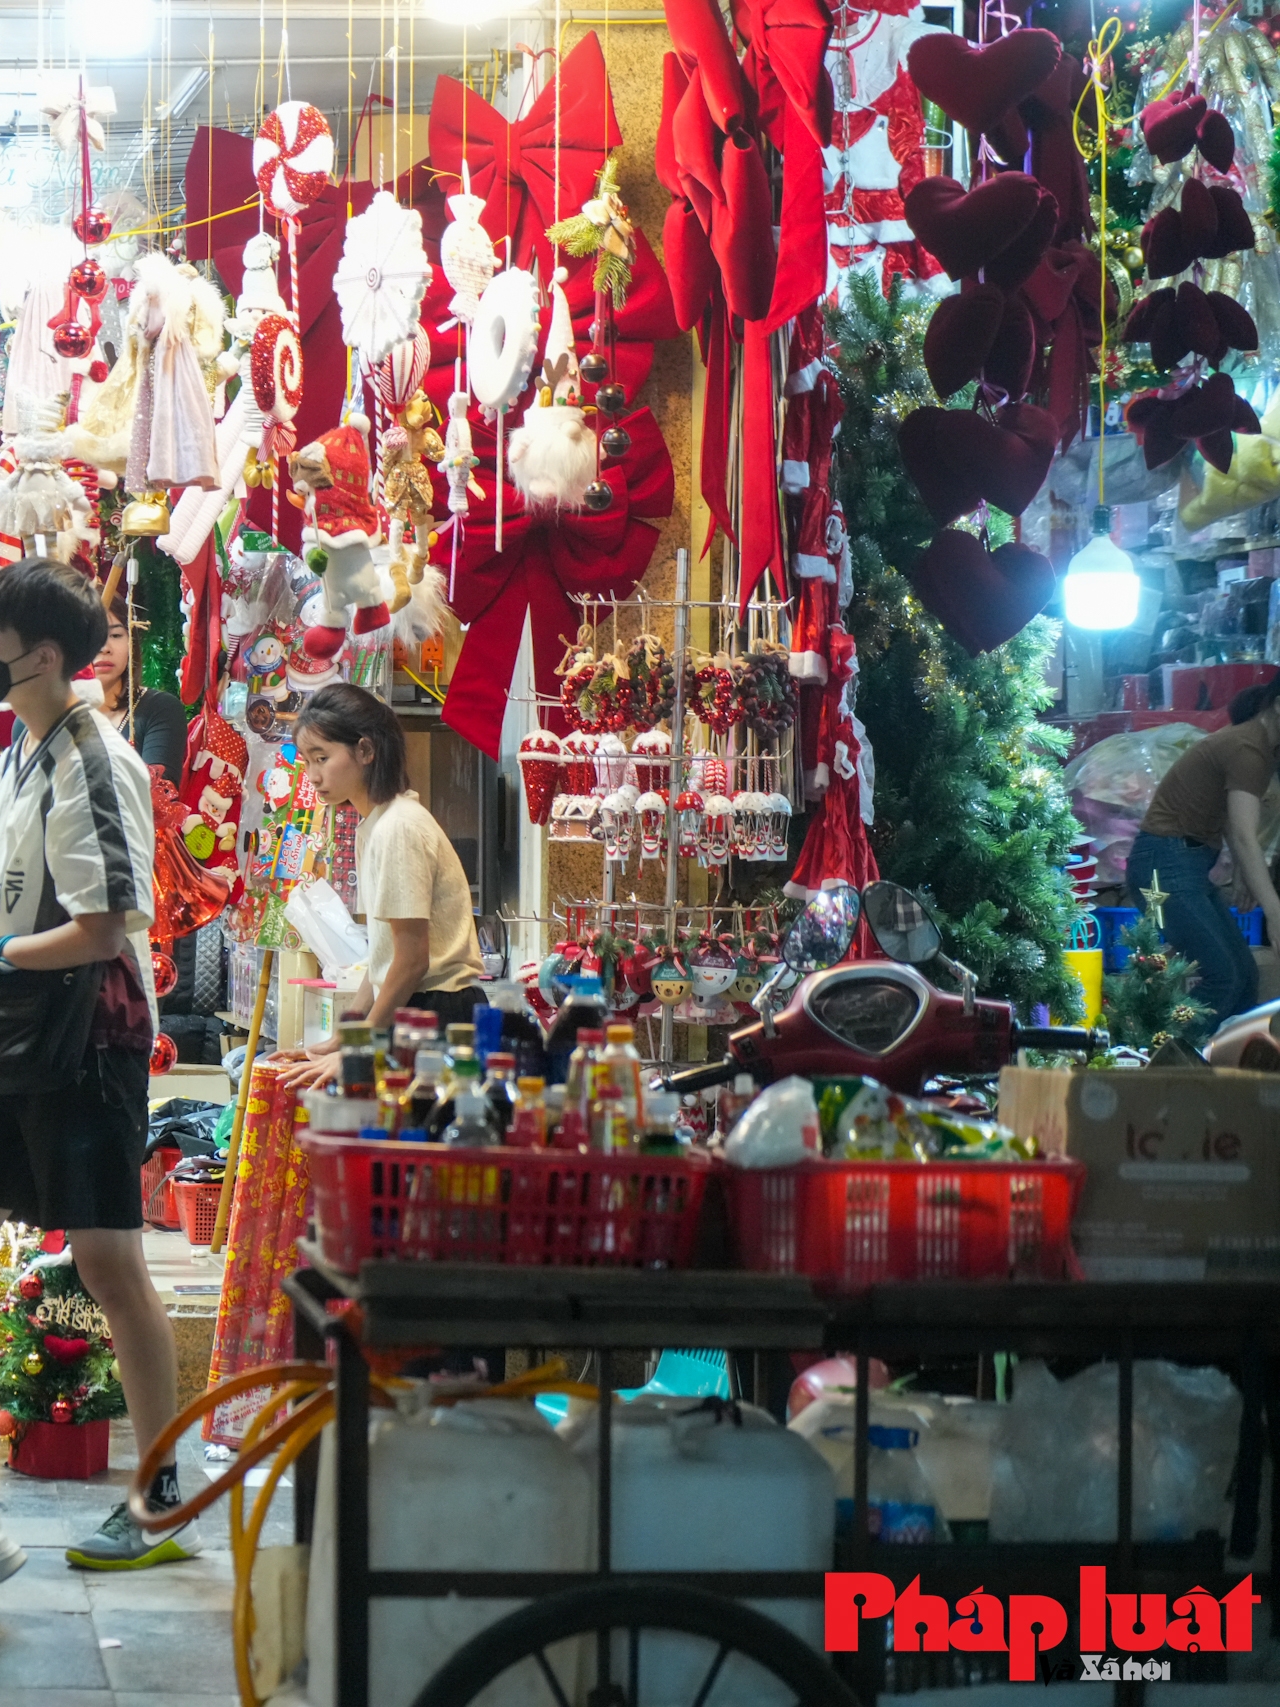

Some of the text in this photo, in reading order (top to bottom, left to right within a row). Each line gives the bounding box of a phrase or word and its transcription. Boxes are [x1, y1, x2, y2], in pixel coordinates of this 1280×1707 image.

[279, 839, 294, 867] Let
[290, 834, 304, 861] Snow
[161, 1475, 180, 1503] LA
